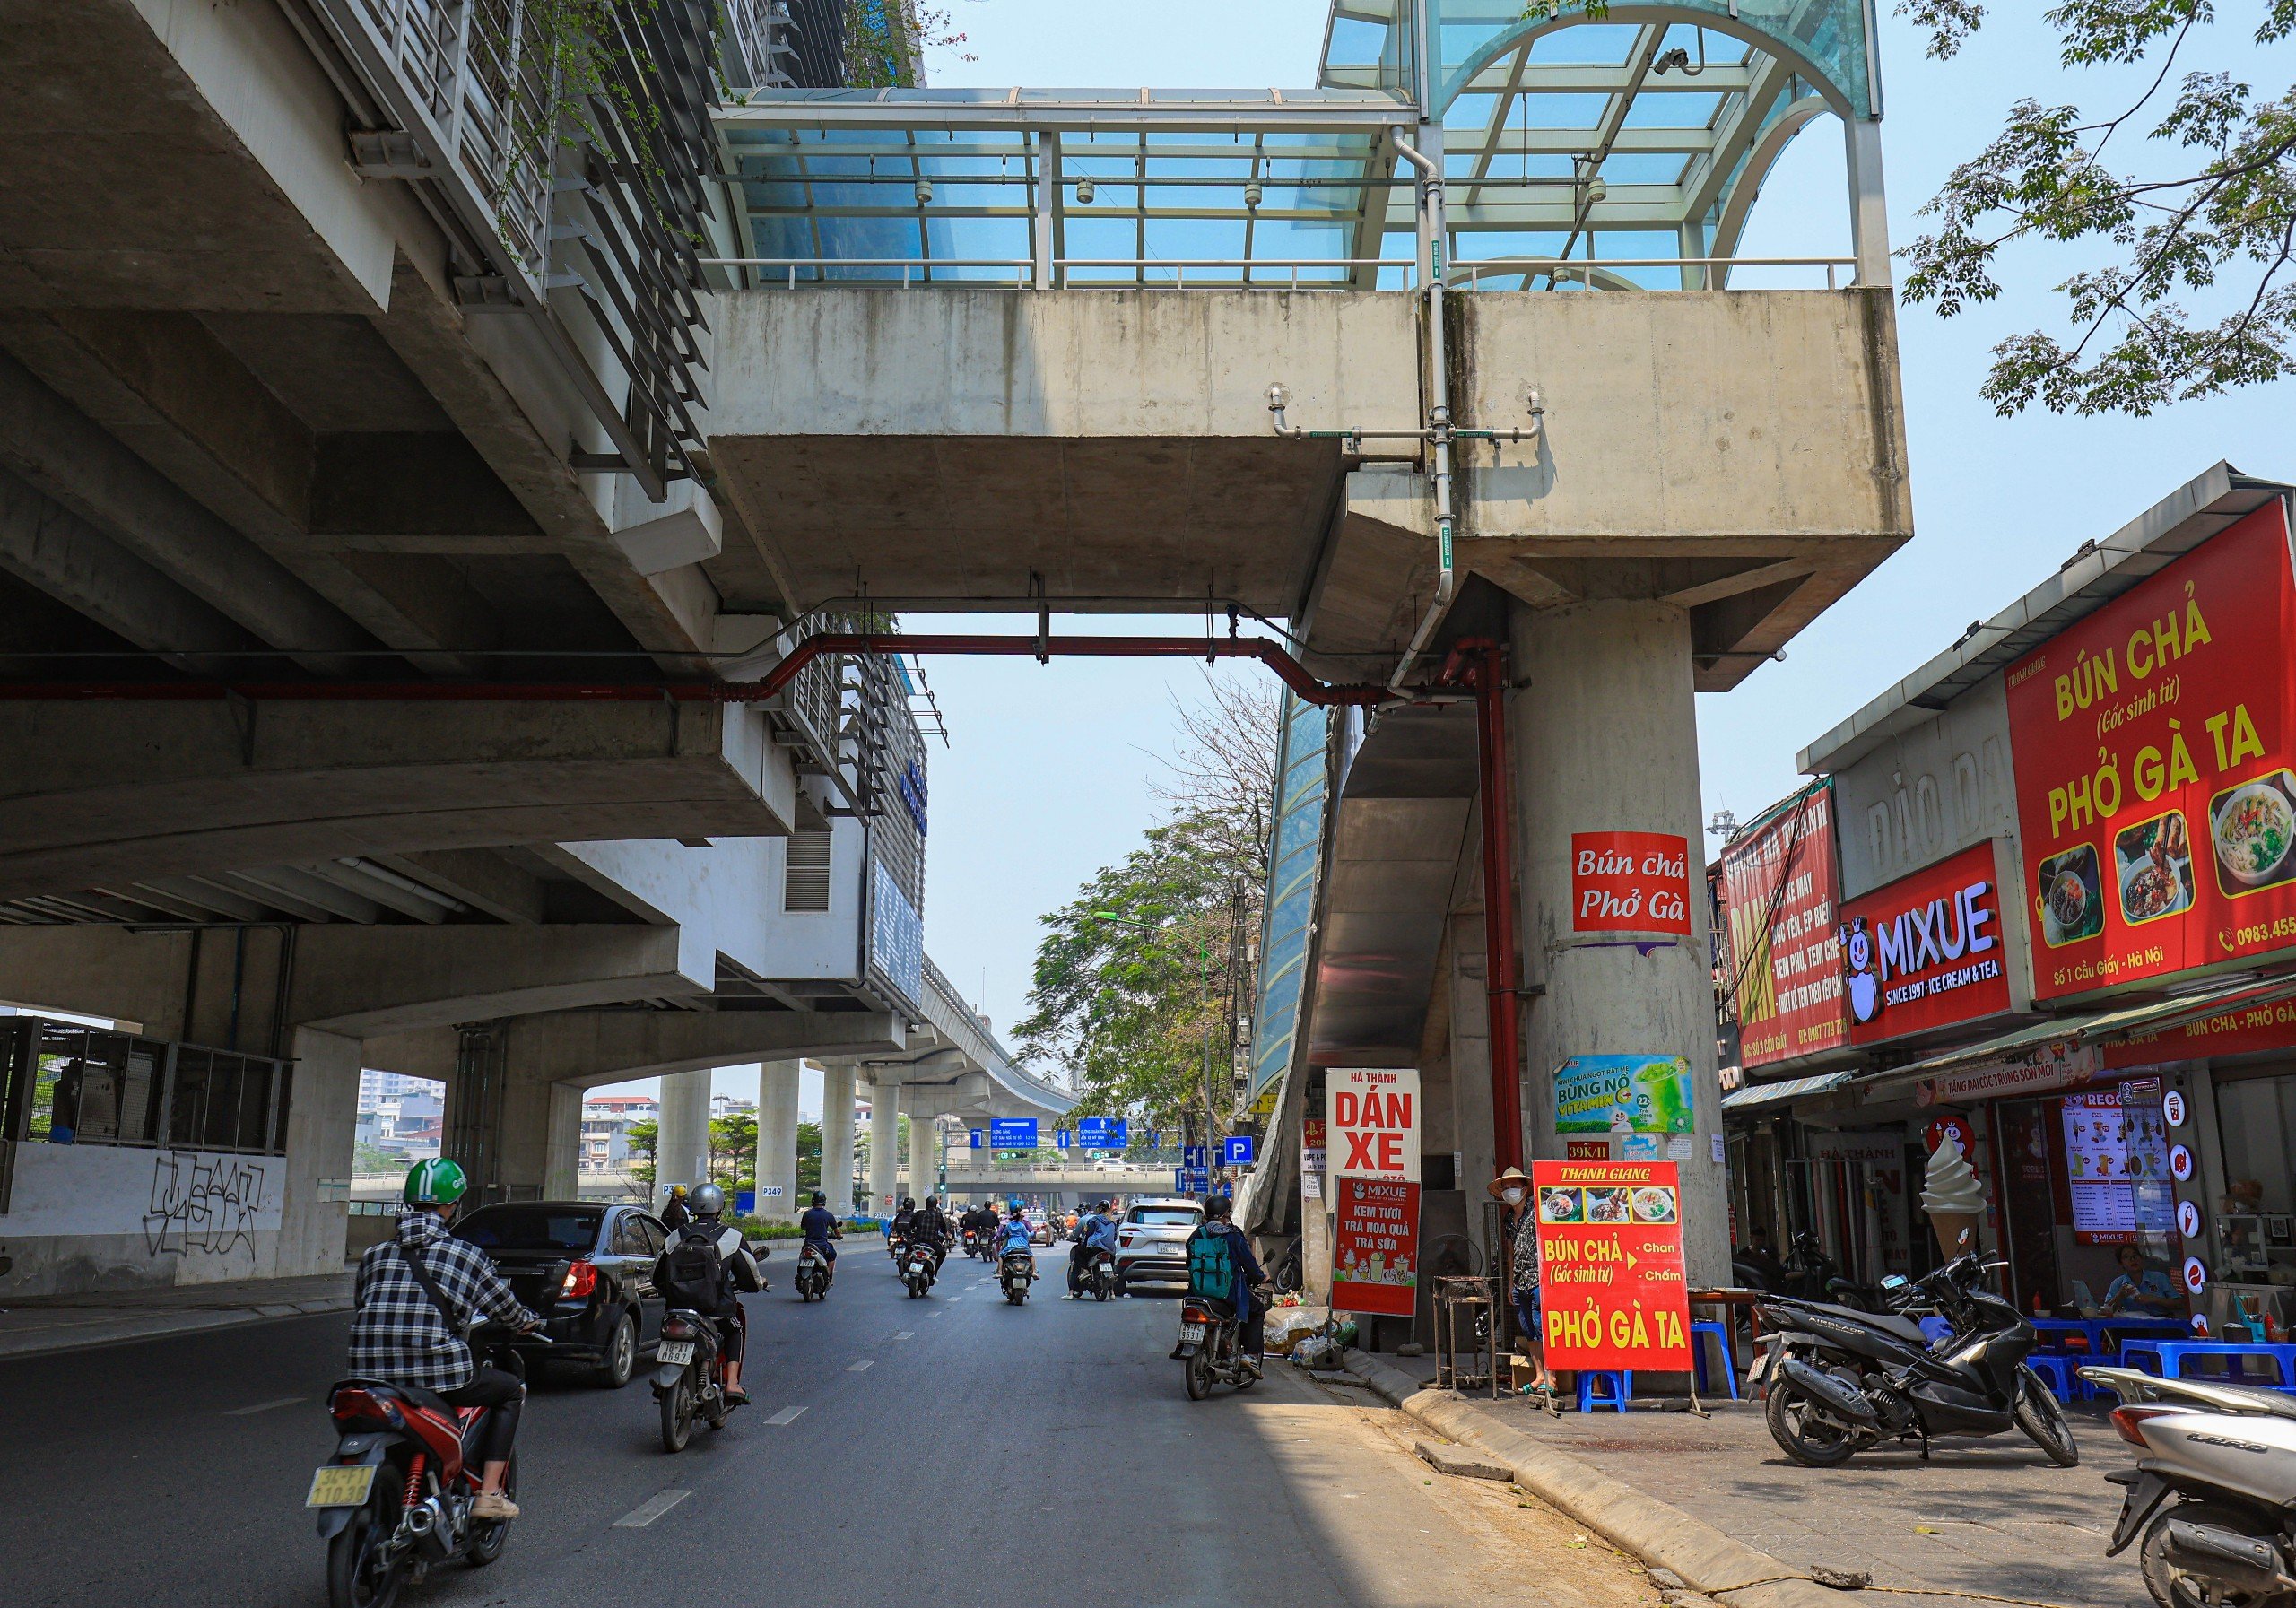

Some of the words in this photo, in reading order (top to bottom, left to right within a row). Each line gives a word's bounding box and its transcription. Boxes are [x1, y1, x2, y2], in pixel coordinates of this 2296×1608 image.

[2055, 648, 2118, 721] BÚN
[2126, 580, 2212, 679] CHẢ
[2097, 702, 2125, 740] (Gốc
[2126, 689, 2156, 721] sinh
[2159, 674, 2180, 706] từ)
[2048, 745, 2122, 838] PHỞ
[2134, 718, 2199, 801] GÀ
[2205, 704, 2266, 772] TA
[1577, 849, 1635, 876] Bún
[1641, 853, 1686, 880] chả
[1580, 888, 1643, 918] Phở
[1648, 891, 1685, 921] Gà
[1878, 882, 1994, 981] MIXUE
[1775, 956, 1789, 980] TEM
[1807, 940, 1824, 969] TEM
[2054, 966, 2065, 986] Số
[2067, 969, 2072, 983] 1
[2075, 960, 2094, 981] Cầu
[2097, 951, 2119, 976] Giấy
[2127, 952, 2143, 969] Hà
[2145, 946, 2164, 967] Nội
[1886, 984, 1909, 1006] SINCE
[1909, 982, 1925, 1001] 1997
[1928, 978, 1941, 995] ICE
[1942, 968, 1971, 991] CREAM
[1972, 966, 1979, 982] &
[1980, 960, 1999, 980] TEA
[2247, 1004, 2273, 1029] PHỞ
[1351, 1071, 1363, 1083] HÀ
[1366, 1071, 1397, 1084] THÀNH
[1994, 1067, 2019, 1088] TRÚNG
[2038, 1062, 2054, 1079] MÔI
[1558, 1080, 1601, 1104] BÙNG
[1605, 1073, 1631, 1092] NỔ
[1335, 1084, 1412, 1129] DÁN
[1558, 1093, 1614, 1118] VITAMIN
[1233, 1143, 1246, 1159] P
[1344, 1132, 1405, 1170] XE
[1570, 1146, 1606, 1158] 39K/H
[1561, 1168, 1606, 1180] THANH
[1609, 1168, 1651, 1180] GIANG
[664, 1184, 688, 1195] P3
[763, 1186, 782, 1195] P349
[1368, 1185, 1407, 1197] MIXUE
[1354, 1205, 1376, 1218] KEM
[1379, 1207, 1402, 1220] TƯƠI
[1344, 1219, 1363, 1232] TRÀ
[1366, 1221, 1386, 1234] HOA
[1389, 1221, 1409, 1237] QUẢ
[1355, 1236, 1374, 1249] TRÀ
[1377, 1237, 1397, 1251] SỮA
[1544, 1233, 1578, 1262] BÚN
[1584, 1232, 1623, 1262] CHẢ
[1643, 1243, 1675, 1253] Chan
[1550, 1263, 1572, 1286] (Gốc
[1574, 1265, 1596, 1282] sinh
[1598, 1264, 1613, 1287] từ)
[1645, 1269, 1682, 1282] Chấm
[1547, 1297, 1603, 1349] PHỞ
[1610, 1299, 1650, 1349] GÀ
[1654, 1311, 1686, 1349] TA
[662, 1352, 687, 1362] 0697
